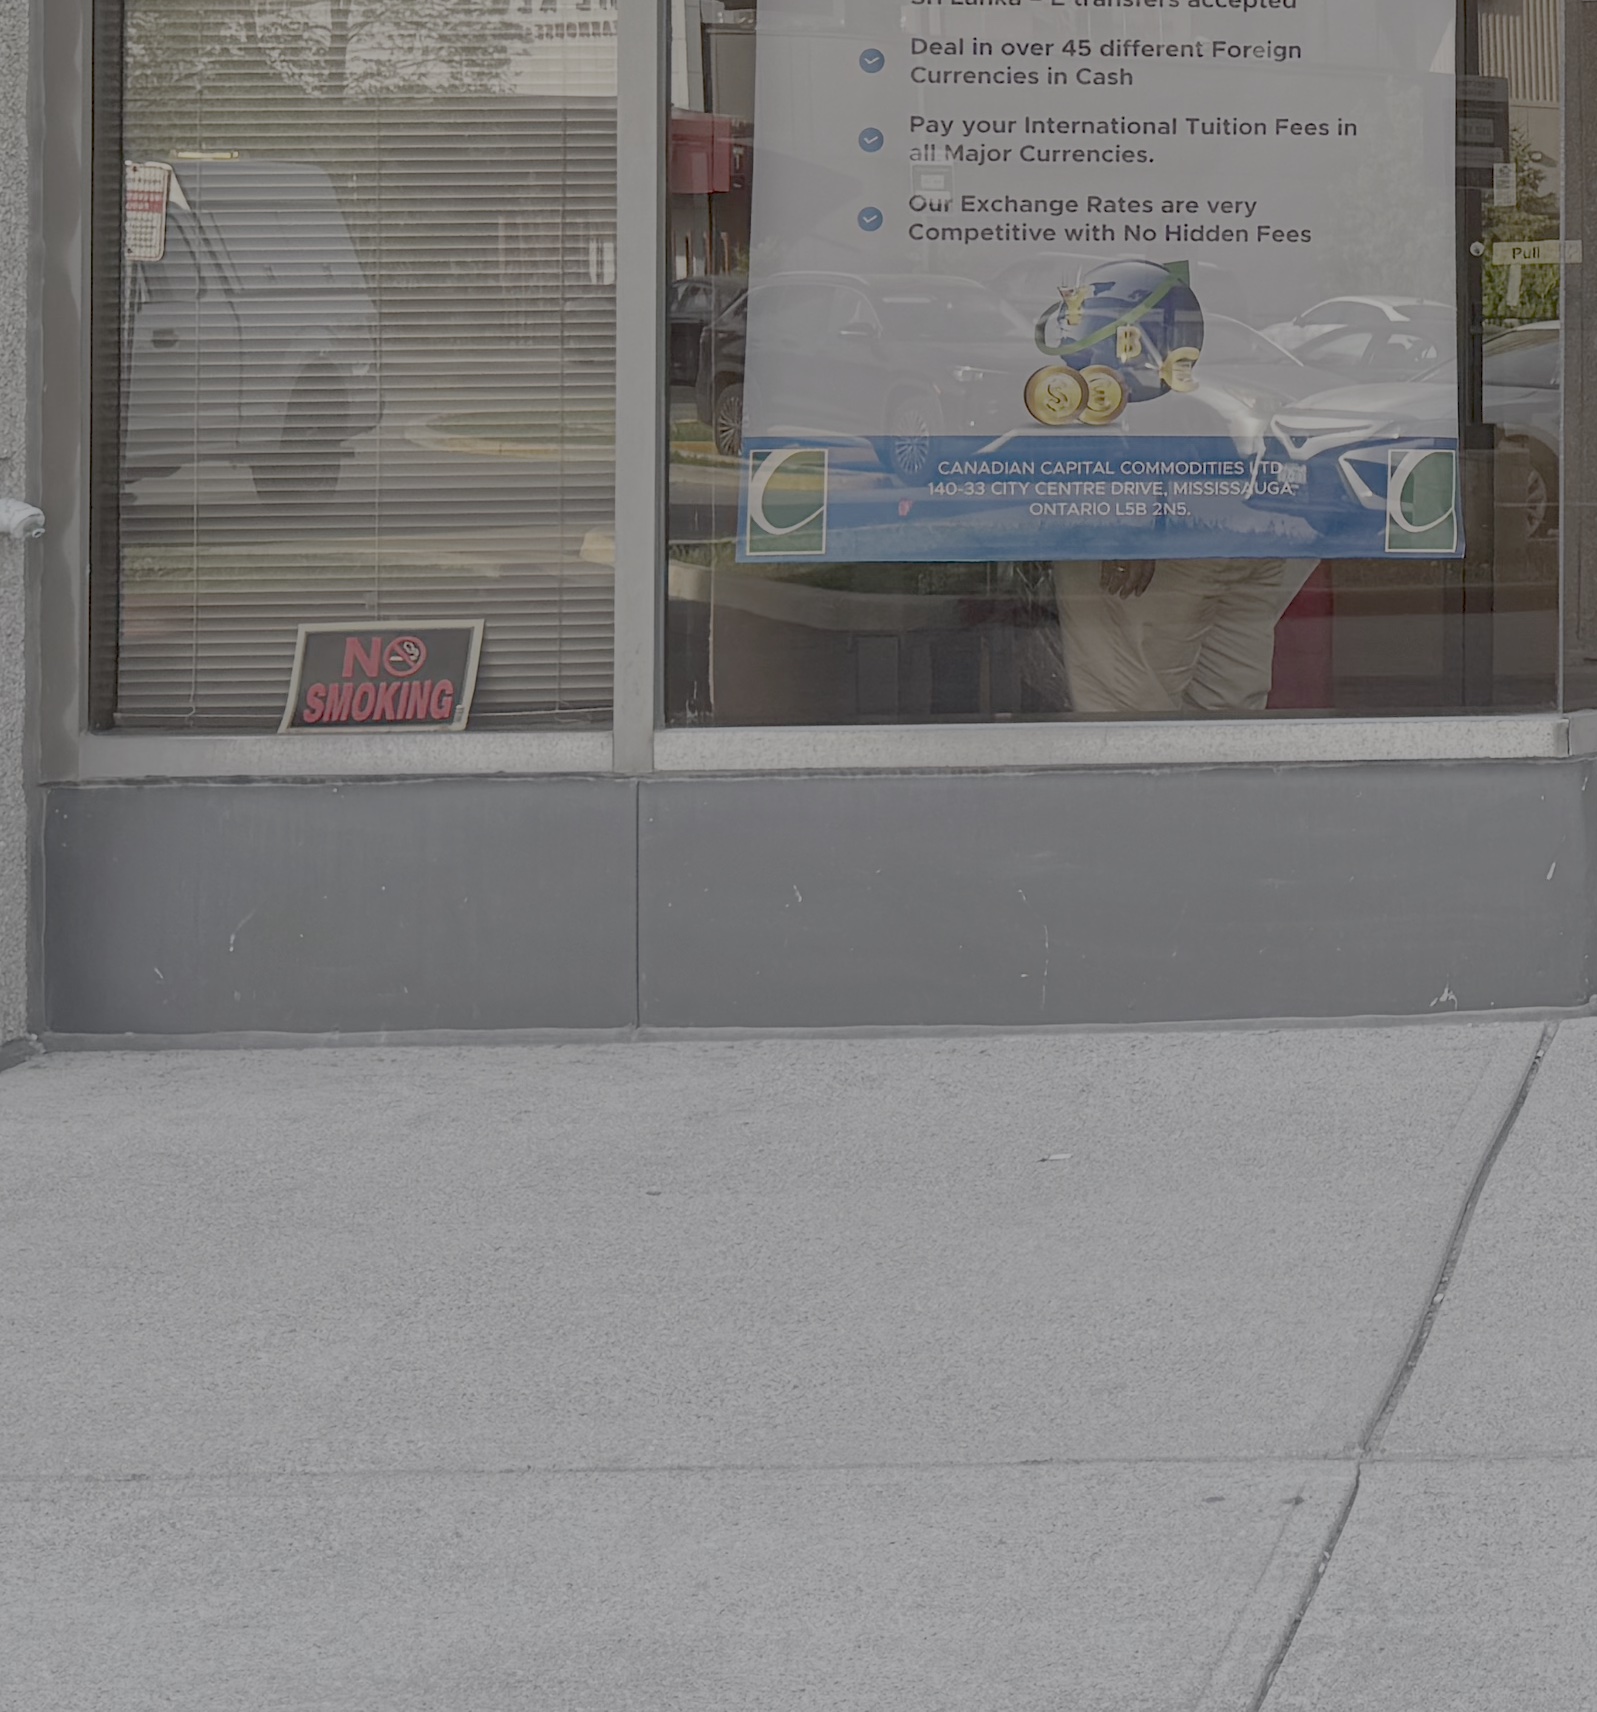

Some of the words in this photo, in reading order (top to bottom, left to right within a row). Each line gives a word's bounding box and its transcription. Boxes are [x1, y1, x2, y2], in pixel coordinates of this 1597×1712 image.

[910, 38, 965, 57] Deal
[972, 38, 993, 57] in
[1001, 42, 1054, 58] over
[1061, 39, 1093, 58] 45
[1099, 39, 1204, 59] different
[1211, 40, 1302, 64] Foreign
[910, 65, 1040, 86] Currencies
[1047, 66, 1068, 86] in
[1075, 67, 1134, 87] Cash
[910, 116, 954, 140] Pay
[961, 120, 1017, 140] your
[1024, 116, 1178, 137] International
[1185, 117, 1267, 137] Tuition
[1274, 118, 1330, 137] Fees
[1337, 118, 1358, 138] in
[909, 144, 937, 163] all
[944, 144, 1013, 168] Major
[1019, 144, 1155, 164] Currencies.
[908, 194, 953, 215] Our
[960, 194, 1079, 220] Exchange
[1086, 195, 1154, 215] Rates
[1161, 199, 1200, 216] are
[1207, 199, 1257, 220] very
[908, 222, 1056, 247] Competitive
[1064, 222, 1116, 243] with
[1123, 223, 1158, 243] No
[1164, 223, 1249, 243] Hidden
[1255, 225, 1312, 243] Fees
[1512, 246, 1540, 259] Pull
[938, 461, 1035, 476] CANADIAN
[1040, 461, 1115, 476] CAPITAL
[1119, 461, 1243, 476] COMMODITIES
[928, 482, 986, 497] 140-33
[991, 482, 1031, 497] CITY
[1035, 482, 1106, 497] CENTRE
[1111, 482, 1168, 498] DRIVE,
[1029, 502, 1111, 516] ONTARIO
[1115, 503, 1147, 516] L5B
[1152, 502, 1191, 517] 2N5.
[341, 635, 427, 678] NO
[302, 679, 454, 724] SMOKING
